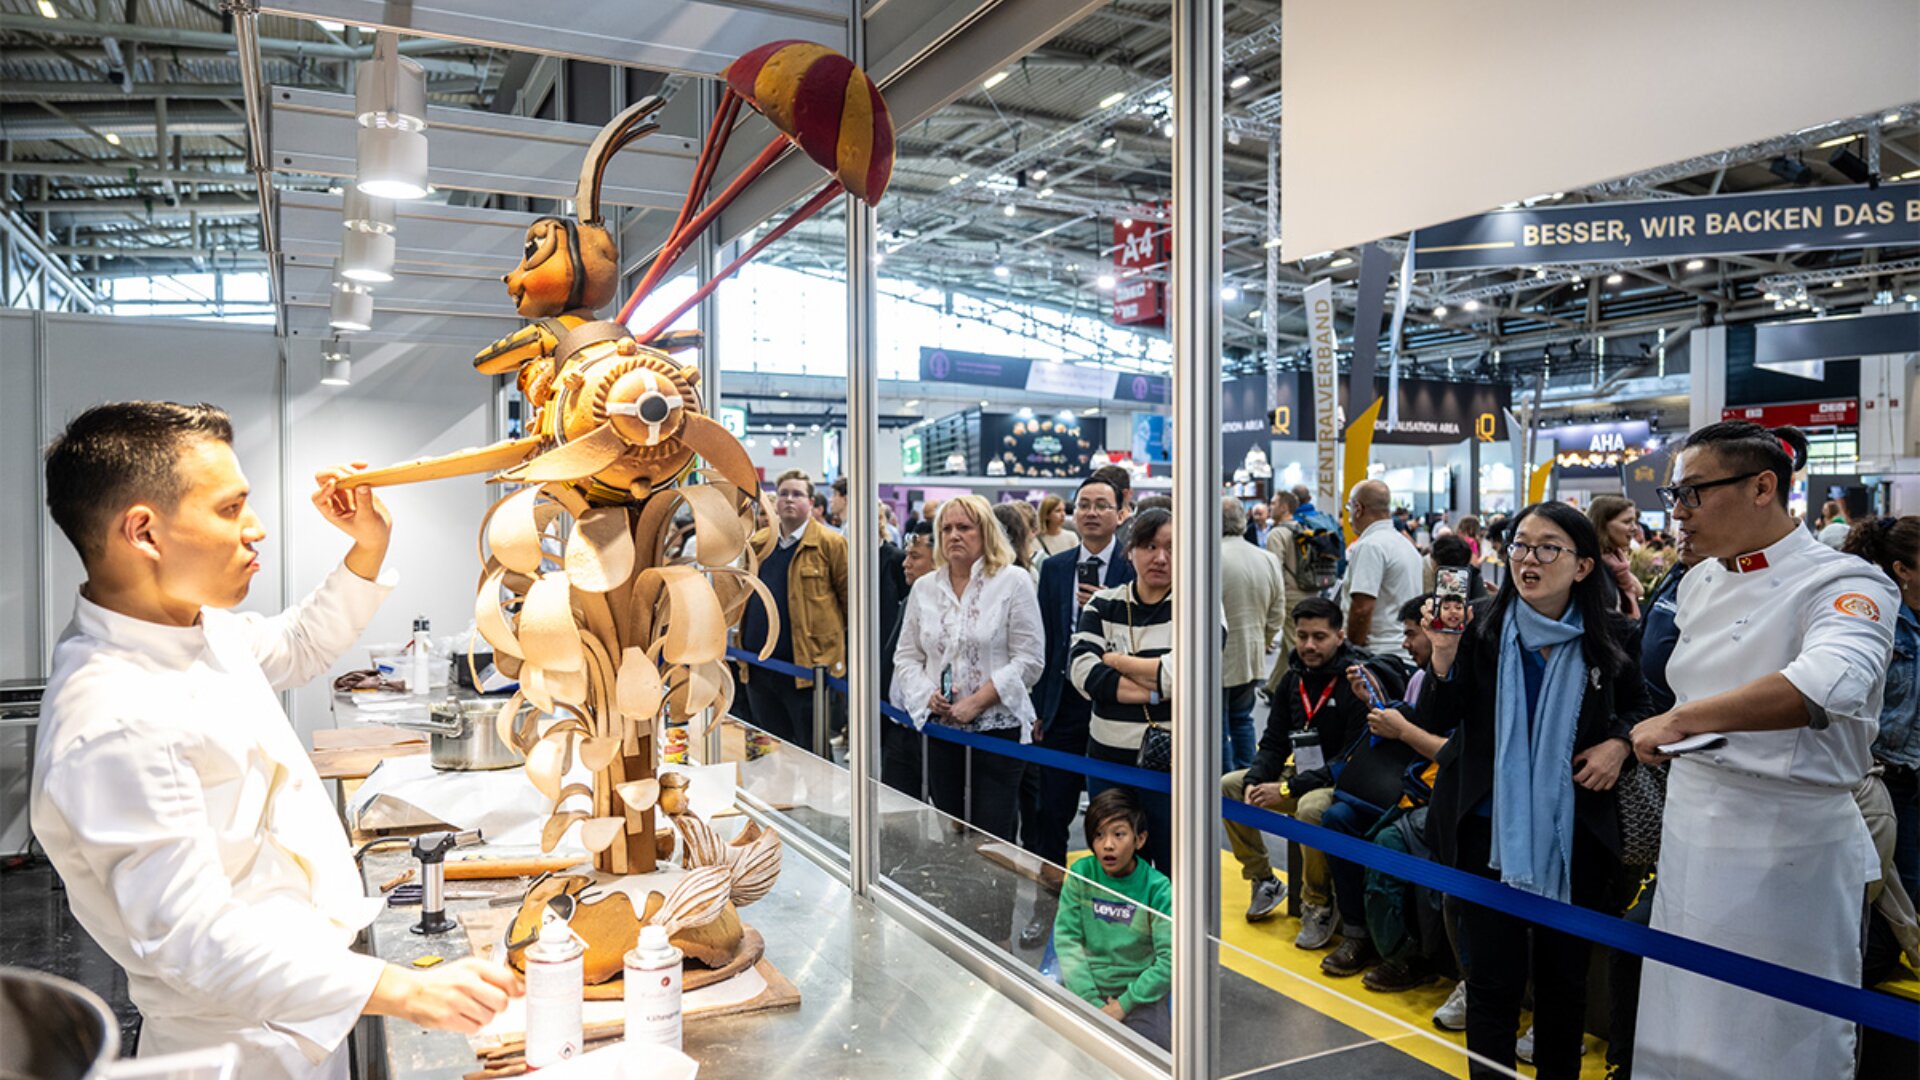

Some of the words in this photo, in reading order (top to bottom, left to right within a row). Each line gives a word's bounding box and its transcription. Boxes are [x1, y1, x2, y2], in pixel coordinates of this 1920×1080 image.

[1523, 219, 1631, 246] BESSER,
[1641, 215, 1696, 239] WIR
[1705, 206, 1823, 236] BACKEN
[1834, 200, 1895, 227] DAS
[1122, 226, 1153, 265] A4
[1315, 299, 1335, 498] ZENTRALVERBAND
[1245, 419, 1264, 432] AREA
[1439, 421, 1460, 434] AREA
[1589, 433, 1625, 452] AHA
